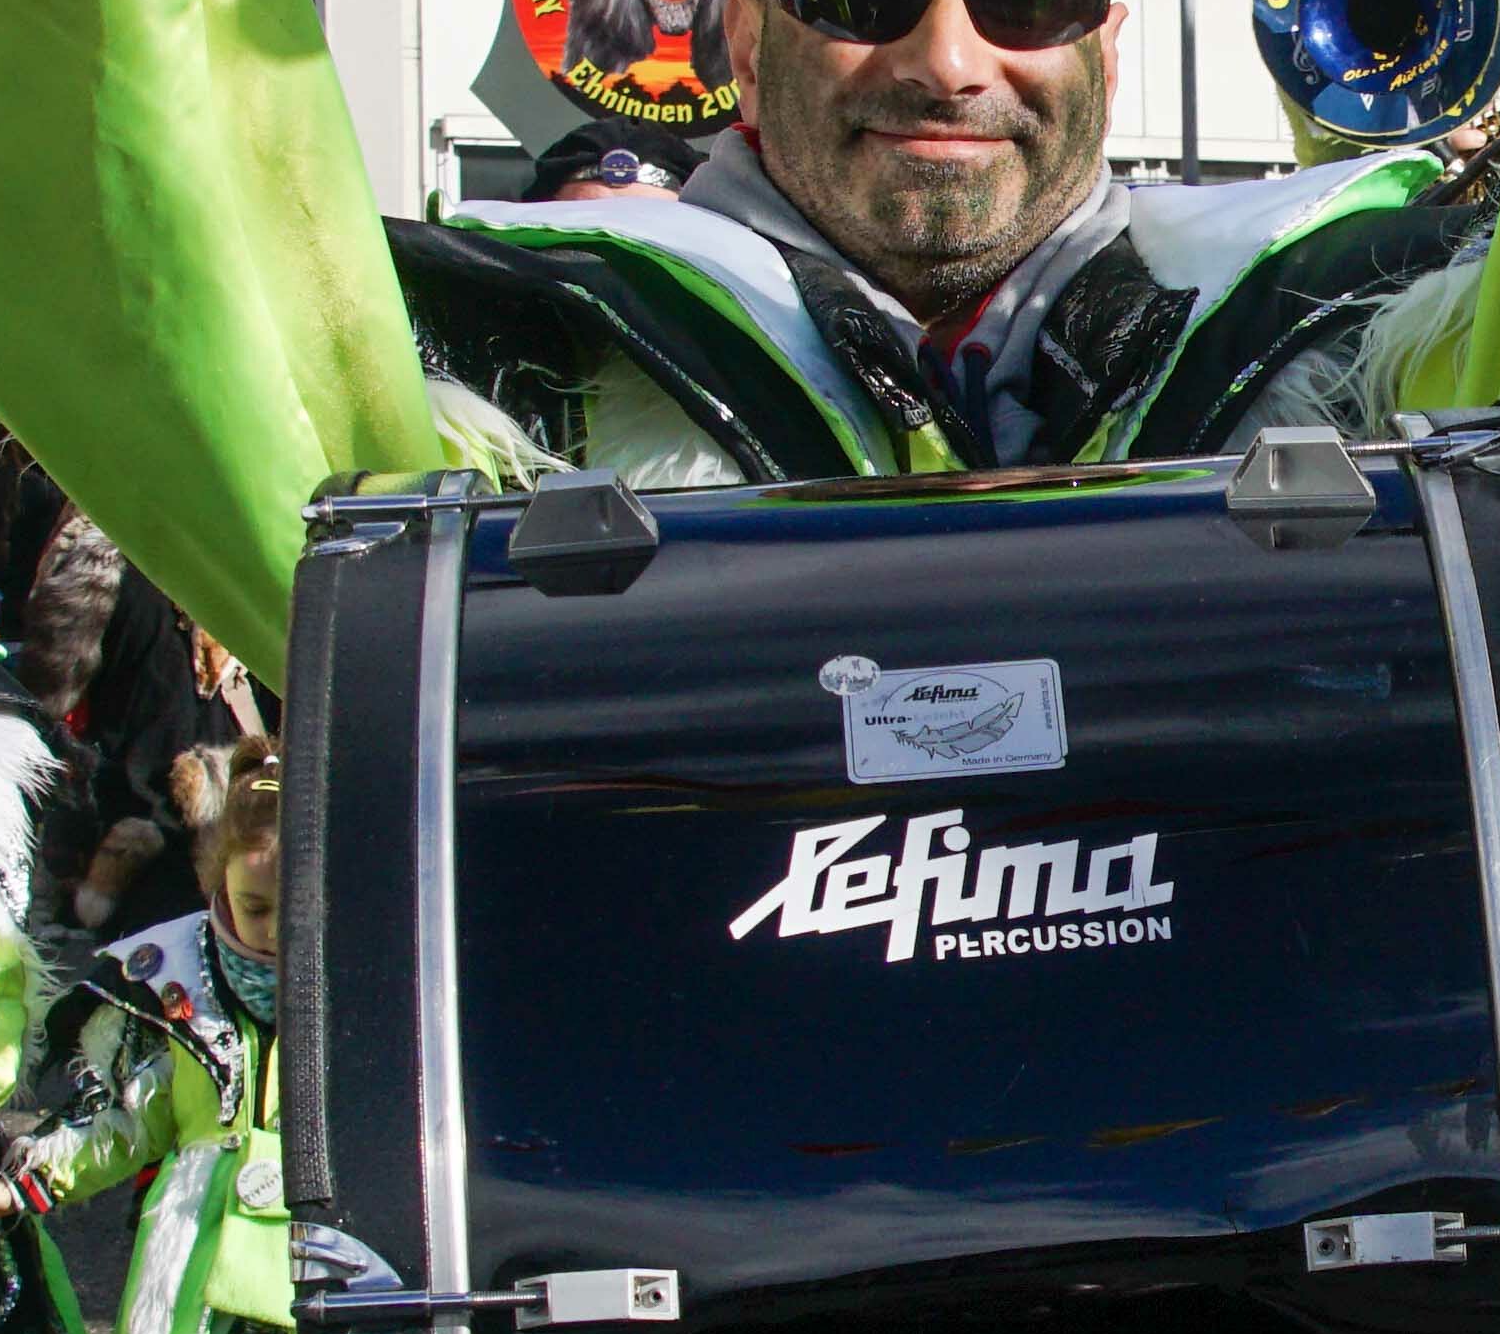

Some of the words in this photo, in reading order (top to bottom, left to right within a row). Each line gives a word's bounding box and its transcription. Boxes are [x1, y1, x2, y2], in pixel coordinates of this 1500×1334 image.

[565, 56, 694, 124] Ehningen
[903, 683, 982, 705] Lefima
[728, 808, 1175, 963] Lefima
[935, 915, 1172, 961] PERCUSSION
